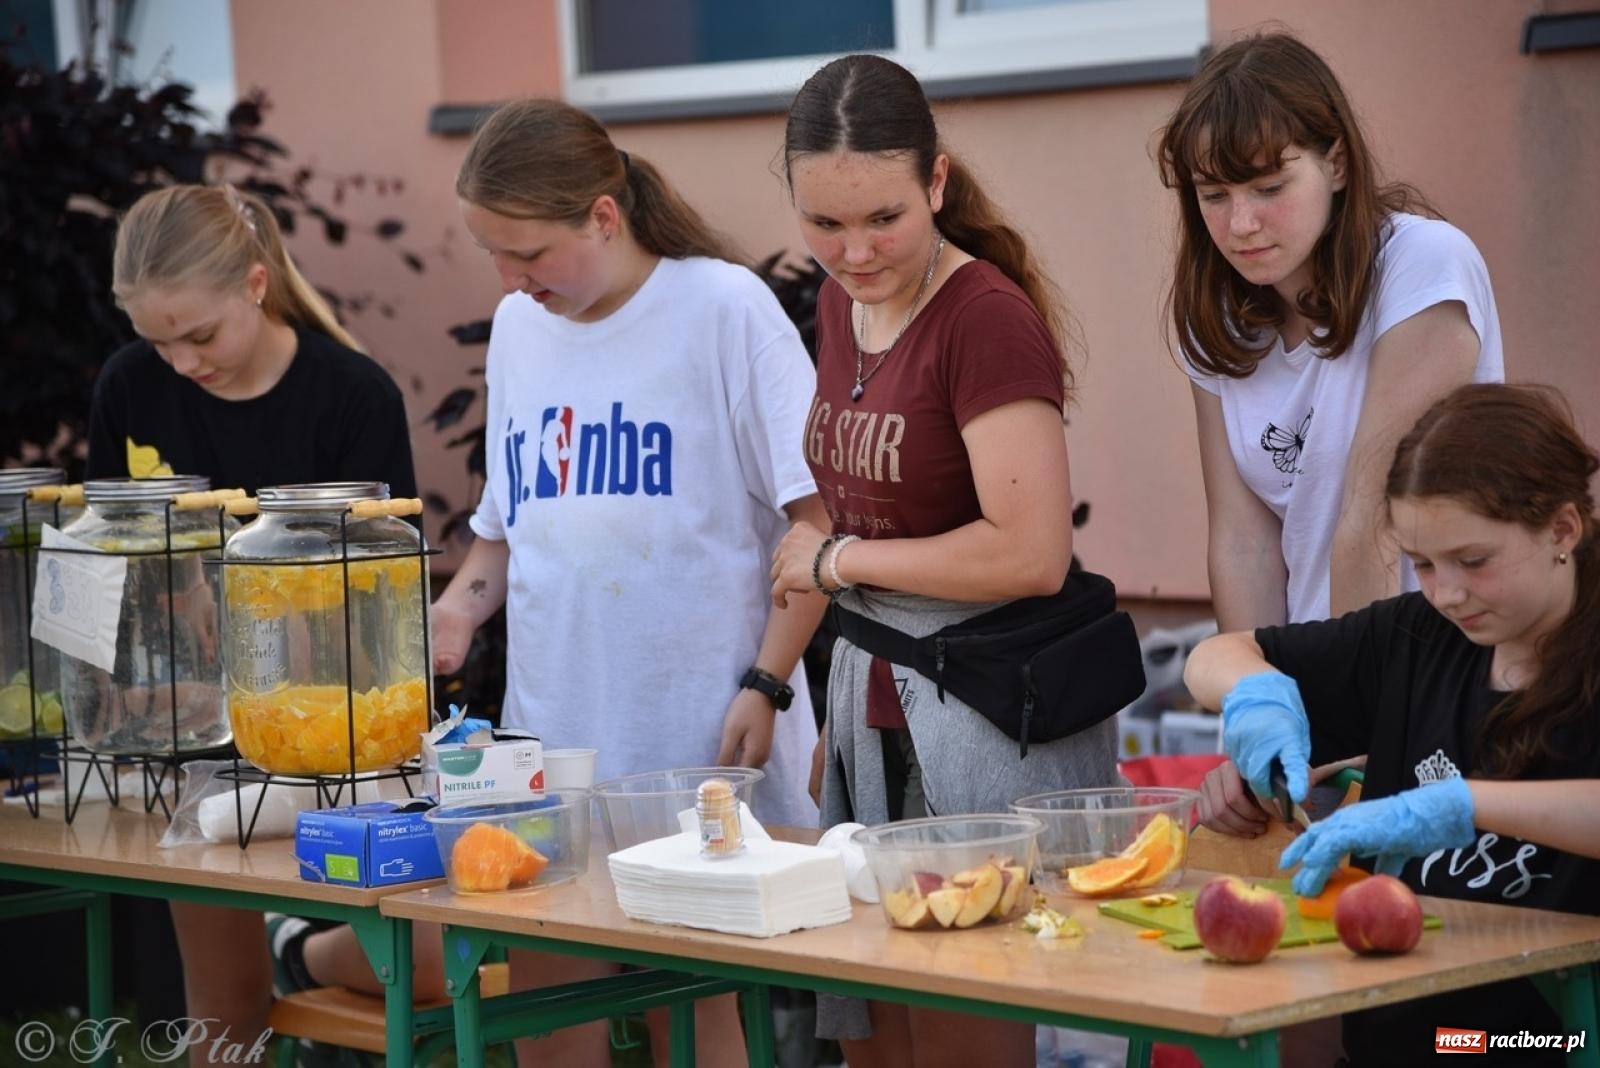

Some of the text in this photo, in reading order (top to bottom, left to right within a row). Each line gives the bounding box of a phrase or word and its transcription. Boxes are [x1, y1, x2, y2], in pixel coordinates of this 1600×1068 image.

[505, 402, 672, 527] jr. nba
[830, 409, 906, 482] STAR
[444, 779, 496, 792] NITRILE PF
